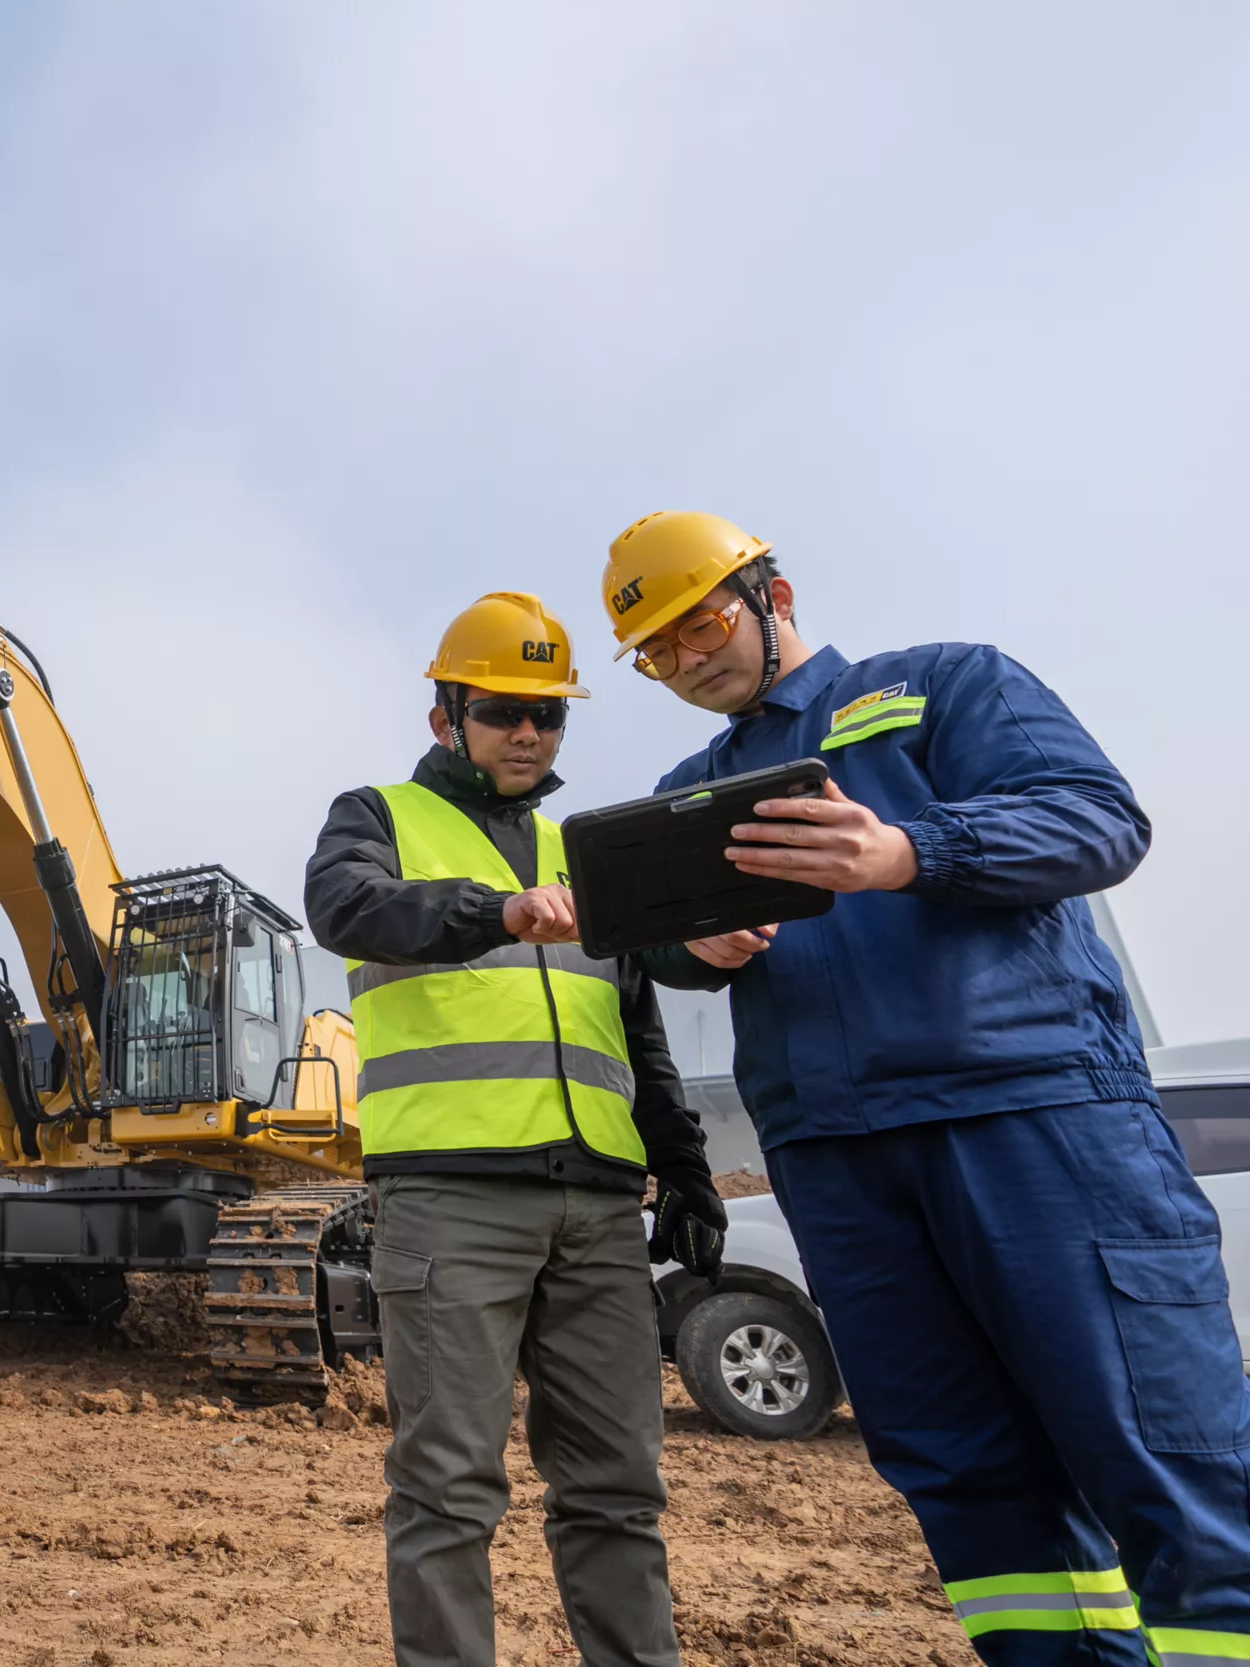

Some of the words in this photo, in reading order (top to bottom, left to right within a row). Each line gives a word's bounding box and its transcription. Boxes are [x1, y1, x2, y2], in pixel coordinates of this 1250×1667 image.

[611, 577, 644, 616] CAT
[522, 640, 557, 664] CAT
[882, 688, 900, 699] CAT
